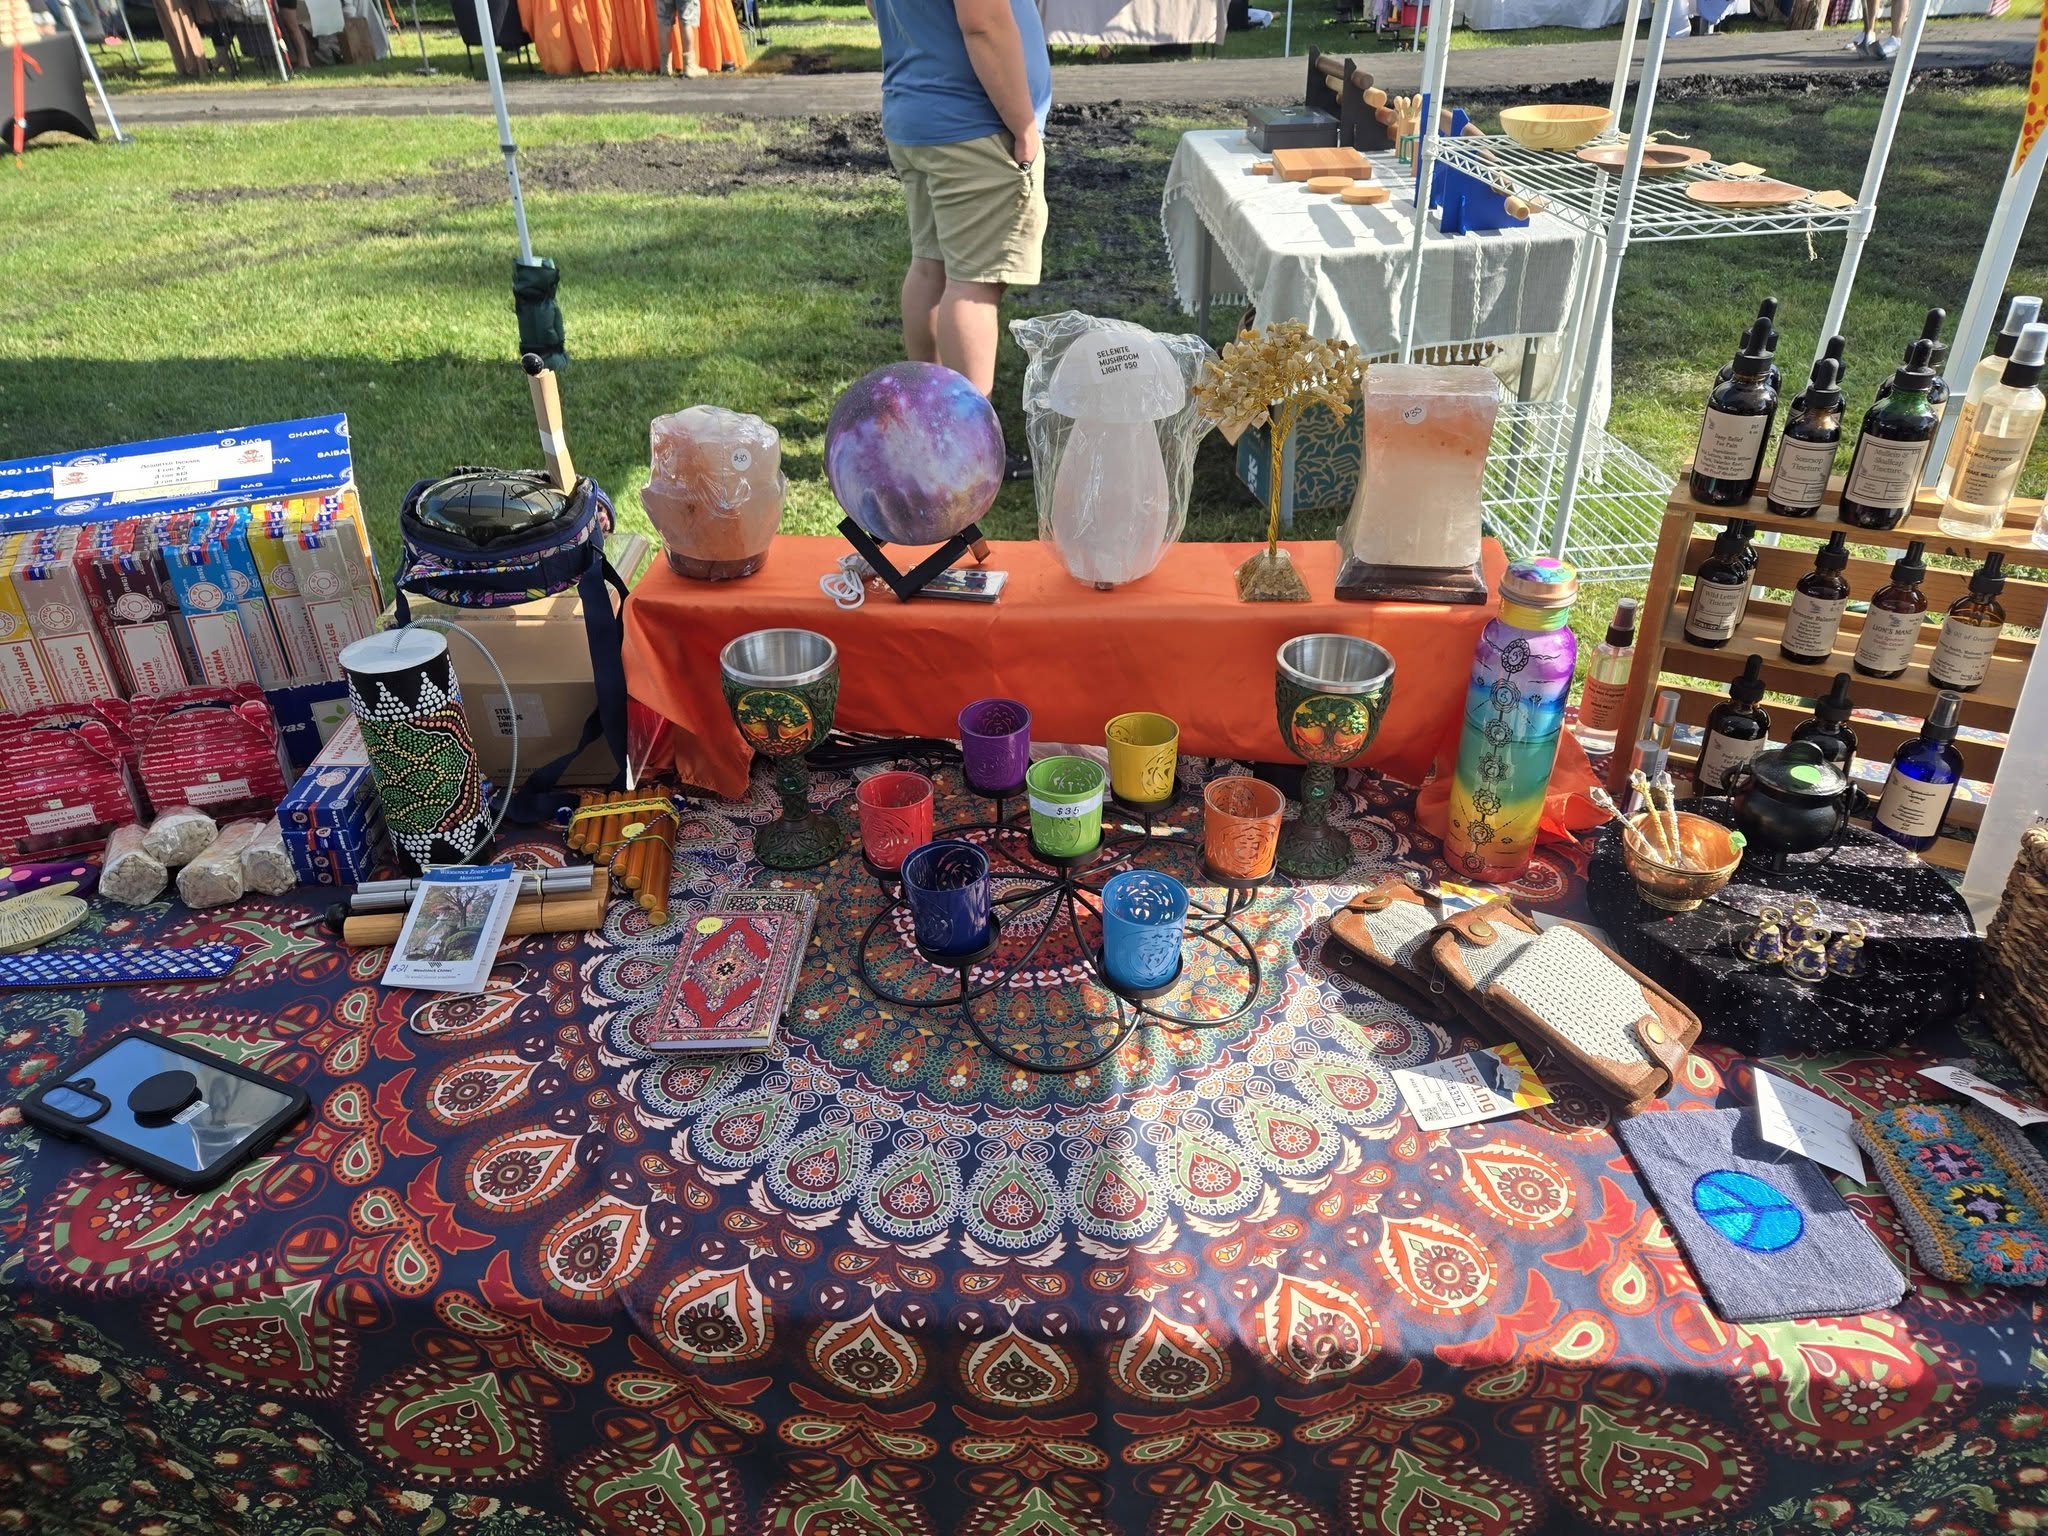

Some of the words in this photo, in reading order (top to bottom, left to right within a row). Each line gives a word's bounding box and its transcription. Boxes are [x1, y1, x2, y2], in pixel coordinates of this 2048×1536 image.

[1097, 346, 1130, 358] SELENITE
[1099, 353, 1139, 367] MUSHROOM
[1101, 364, 1122, 375] LIGHT
[1124, 361, 1138, 369] $50
[288, 428, 330, 439] CHAMPA
[240, 438, 262, 446] NAG
[291, 473, 333, 483] CHAMPA
[325, 623, 340, 649] SAGE
[1872, 624, 1893, 635] LION'S
[250, 632, 267, 670] INCENSE
[298, 626, 316, 663] INCENSE
[12, 646, 39, 697] SPIRITUAL
[73, 646, 98, 692] POSITIVE
[210, 649, 229, 684] KARMA
[142, 661, 160, 694] OPIUM
[331, 745, 345, 760] NAG
[30, 816, 66, 827] DRAGON'S
[67, 812, 91, 820] BLOOD
[1452, 1057, 1496, 1113] Rising
